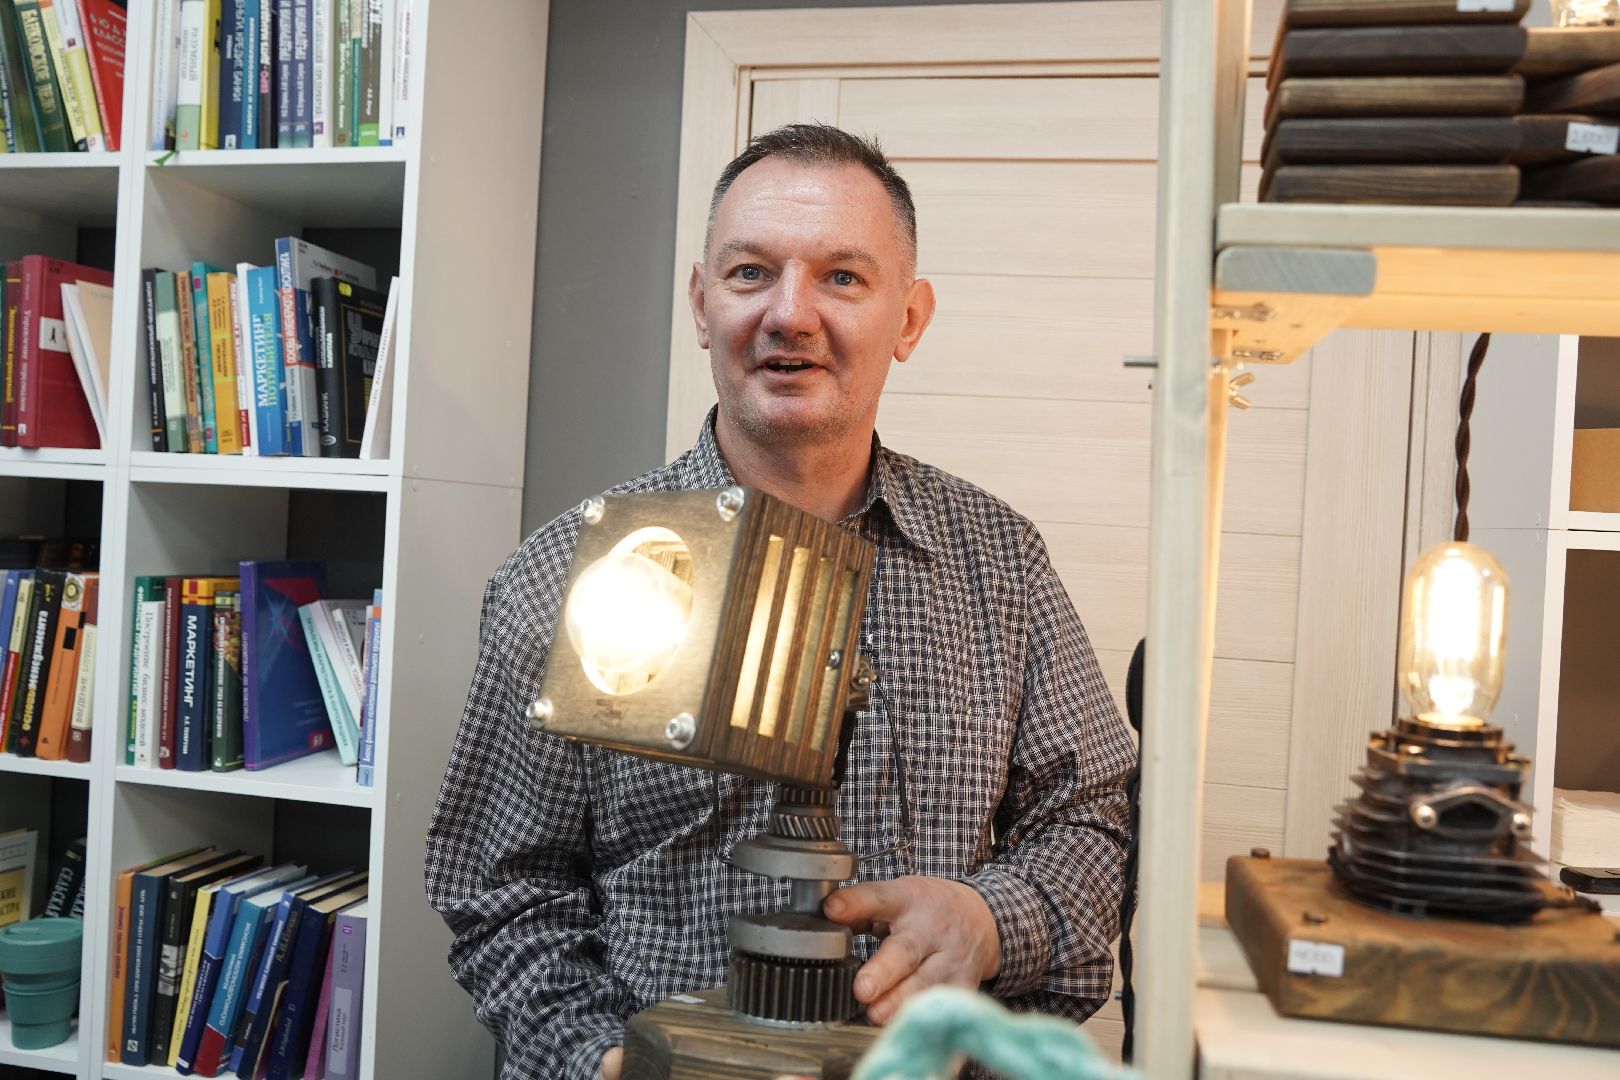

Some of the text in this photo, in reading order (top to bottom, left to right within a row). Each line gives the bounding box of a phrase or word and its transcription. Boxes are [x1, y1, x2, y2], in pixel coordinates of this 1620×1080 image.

[252, 314, 269, 407] МАРКЕТИНГ
[263, 312, 278, 406] ПОТРЕБИТЕЛЯ
[183, 615, 197, 708] МАРКЕТИНГ
